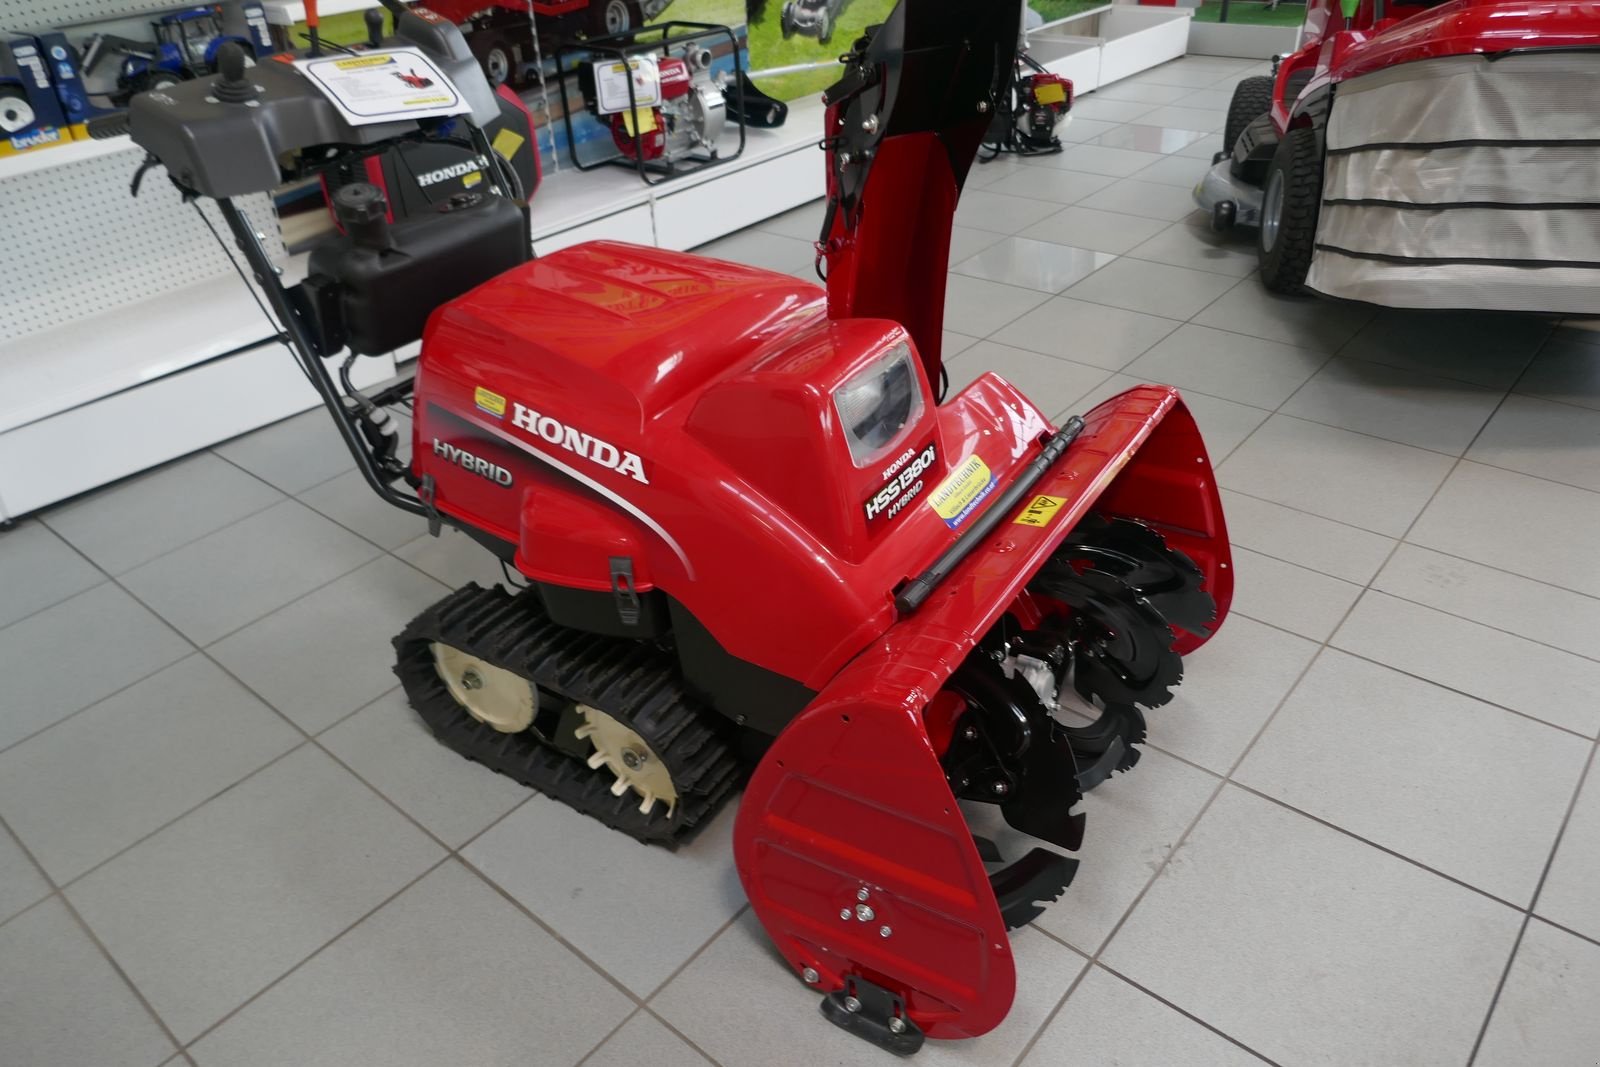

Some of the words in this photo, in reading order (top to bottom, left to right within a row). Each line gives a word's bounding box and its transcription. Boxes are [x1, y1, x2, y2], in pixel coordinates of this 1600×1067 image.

[417, 160, 478, 187] HONDA
[433, 438, 513, 487] HYBRID
[512, 403, 649, 485] HONDA
[882, 448, 916, 481] HONDA
[866, 446, 935, 519] HSS1380i
[888, 480, 923, 519] HYBRID
[934, 458, 982, 507] LANDTECHNIK
